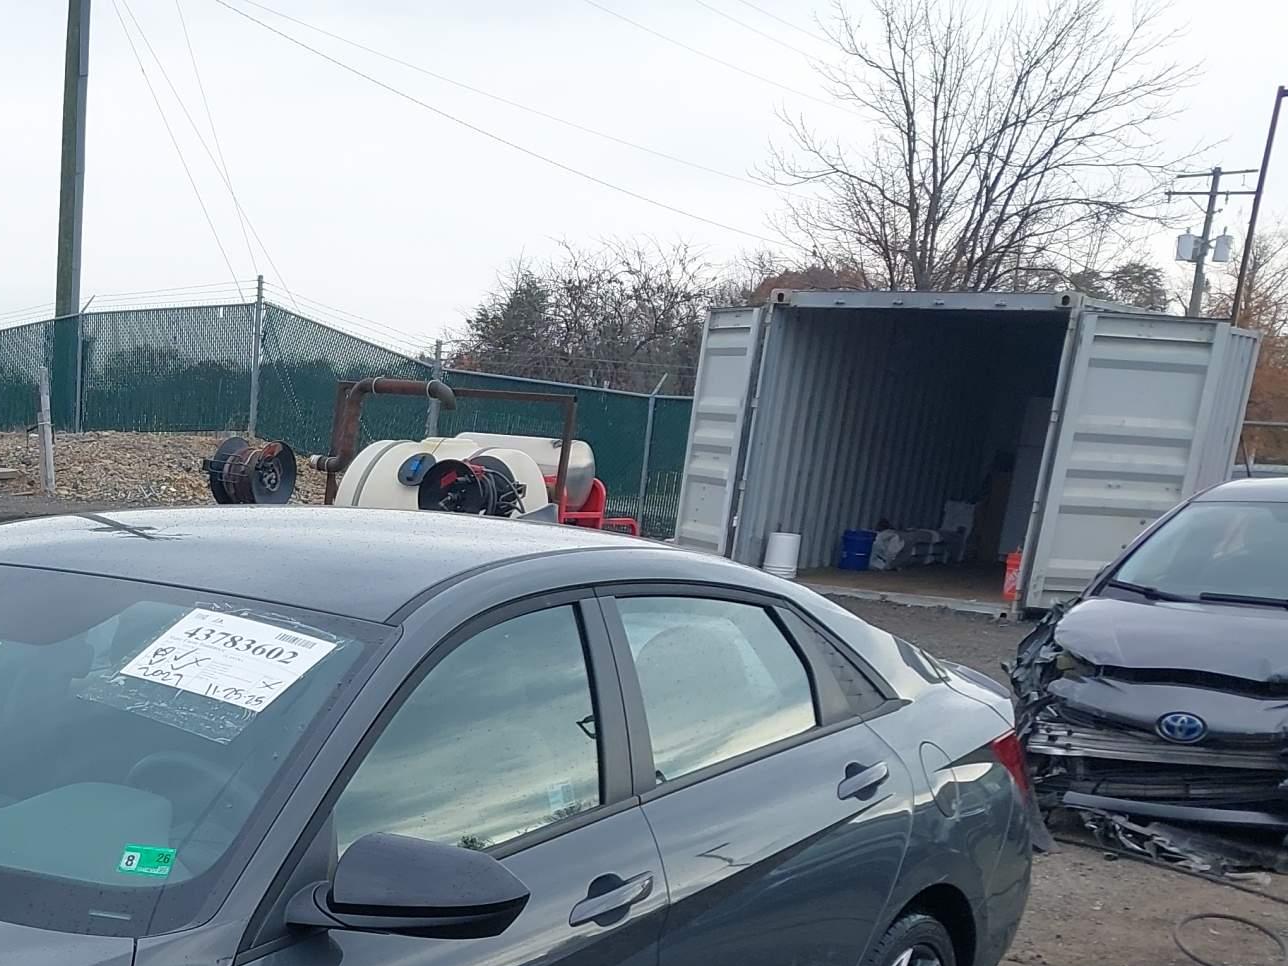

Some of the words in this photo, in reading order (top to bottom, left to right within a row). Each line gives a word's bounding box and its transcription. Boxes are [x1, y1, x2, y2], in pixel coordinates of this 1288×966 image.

[184, 626, 298, 664] 43783602
[138, 666, 183, 686] 2027
[125, 854, 135, 867] 8
[156, 853, 171, 864] 26
